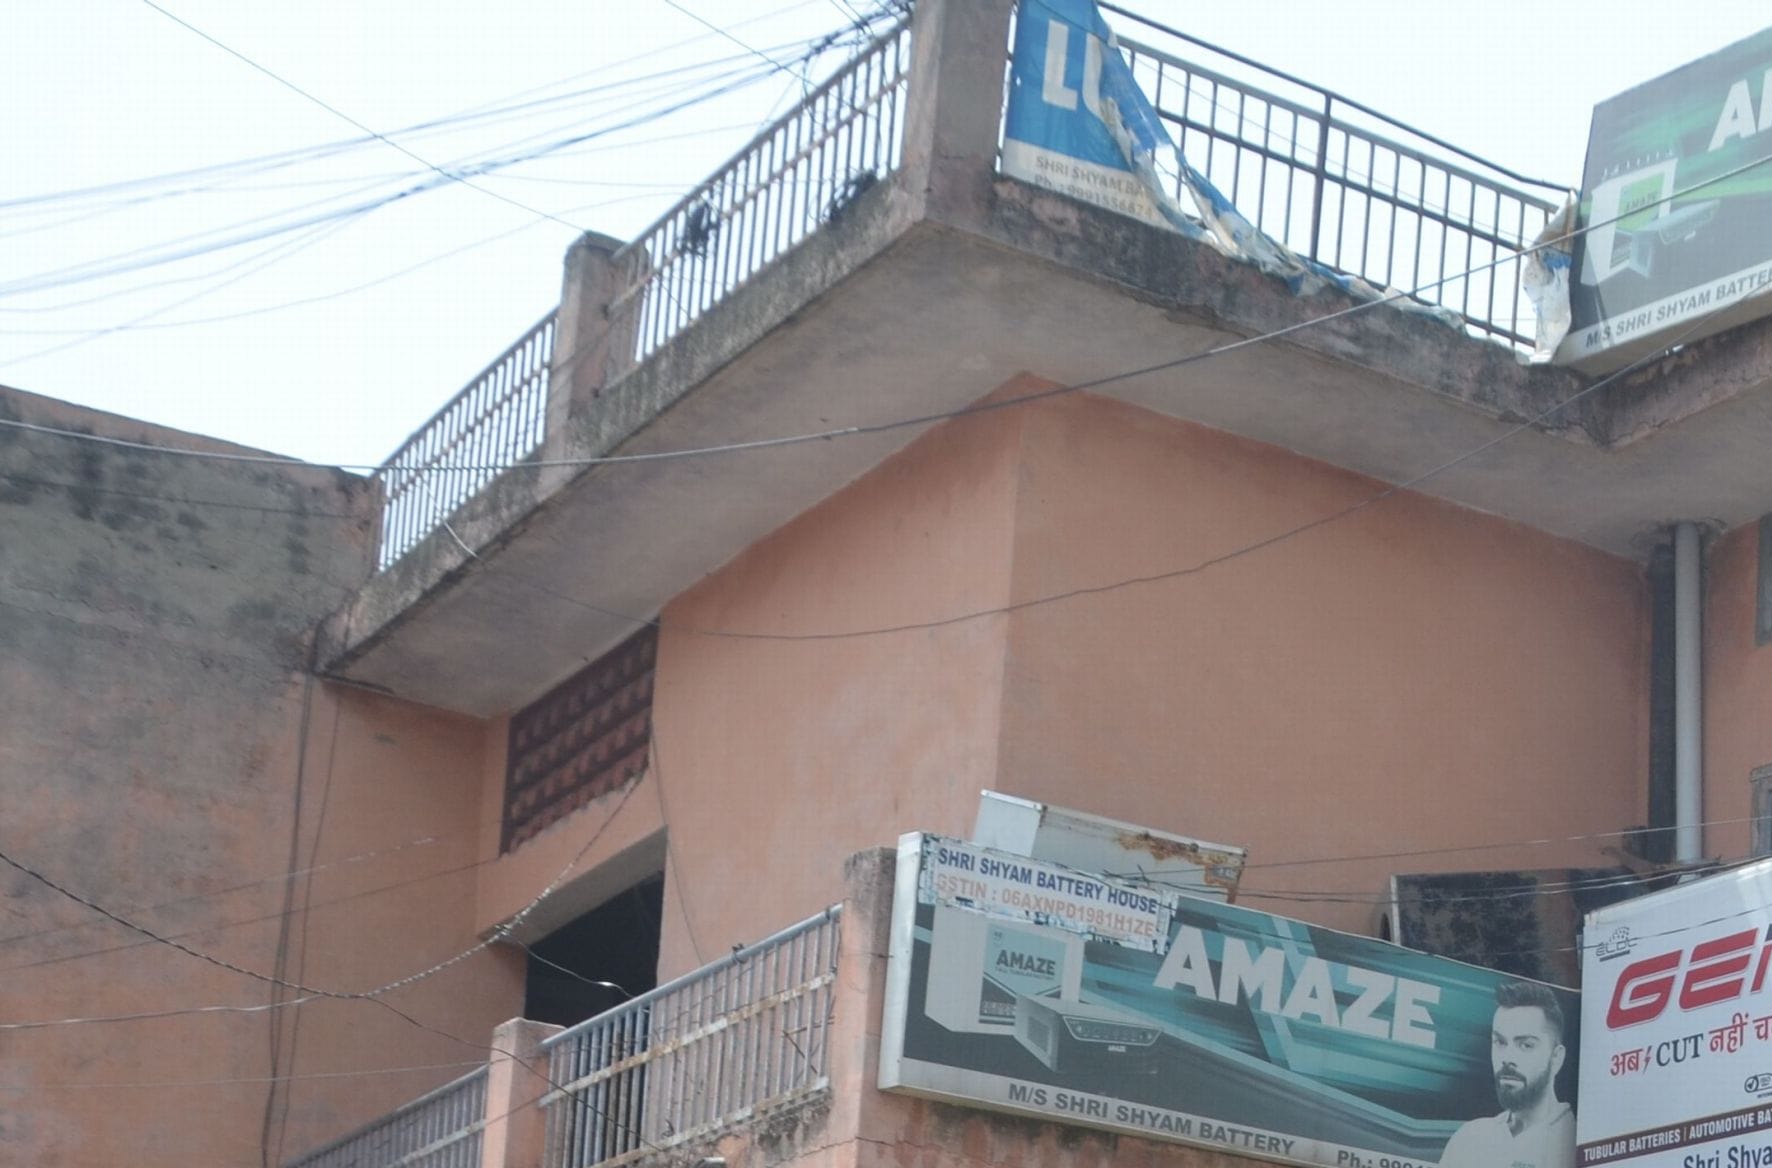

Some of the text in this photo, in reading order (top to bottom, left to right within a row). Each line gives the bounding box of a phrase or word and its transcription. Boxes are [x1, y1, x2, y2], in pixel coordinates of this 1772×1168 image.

[1036, 156, 1121, 192] SHRI SHYAM
[1615, 310, 1652, 338] SHRI
[1656, 289, 1711, 322] SHYAM
[937, 874, 987, 899] GSTIN
[938, 848, 1157, 914] SHRI SHYAM BATTERY HOUSE
[996, 950, 1056, 976] AMAZE
[1153, 925, 1440, 1049] AMAZE
[1610, 1012, 1750, 1077] अब CUT नहीं
[1008, 1082, 1049, 1109] M/S
[1054, 1090, 1109, 1119] SHRI
[1115, 1099, 1192, 1136] SHYAM
[1198, 1120, 1295, 1156] BATTERY
[1583, 1144, 1627, 1164] TUBULAR
[1628, 1130, 1681, 1157] BATTERIES
[1690, 1114, 1754, 1140] AUTOMOTIVE
